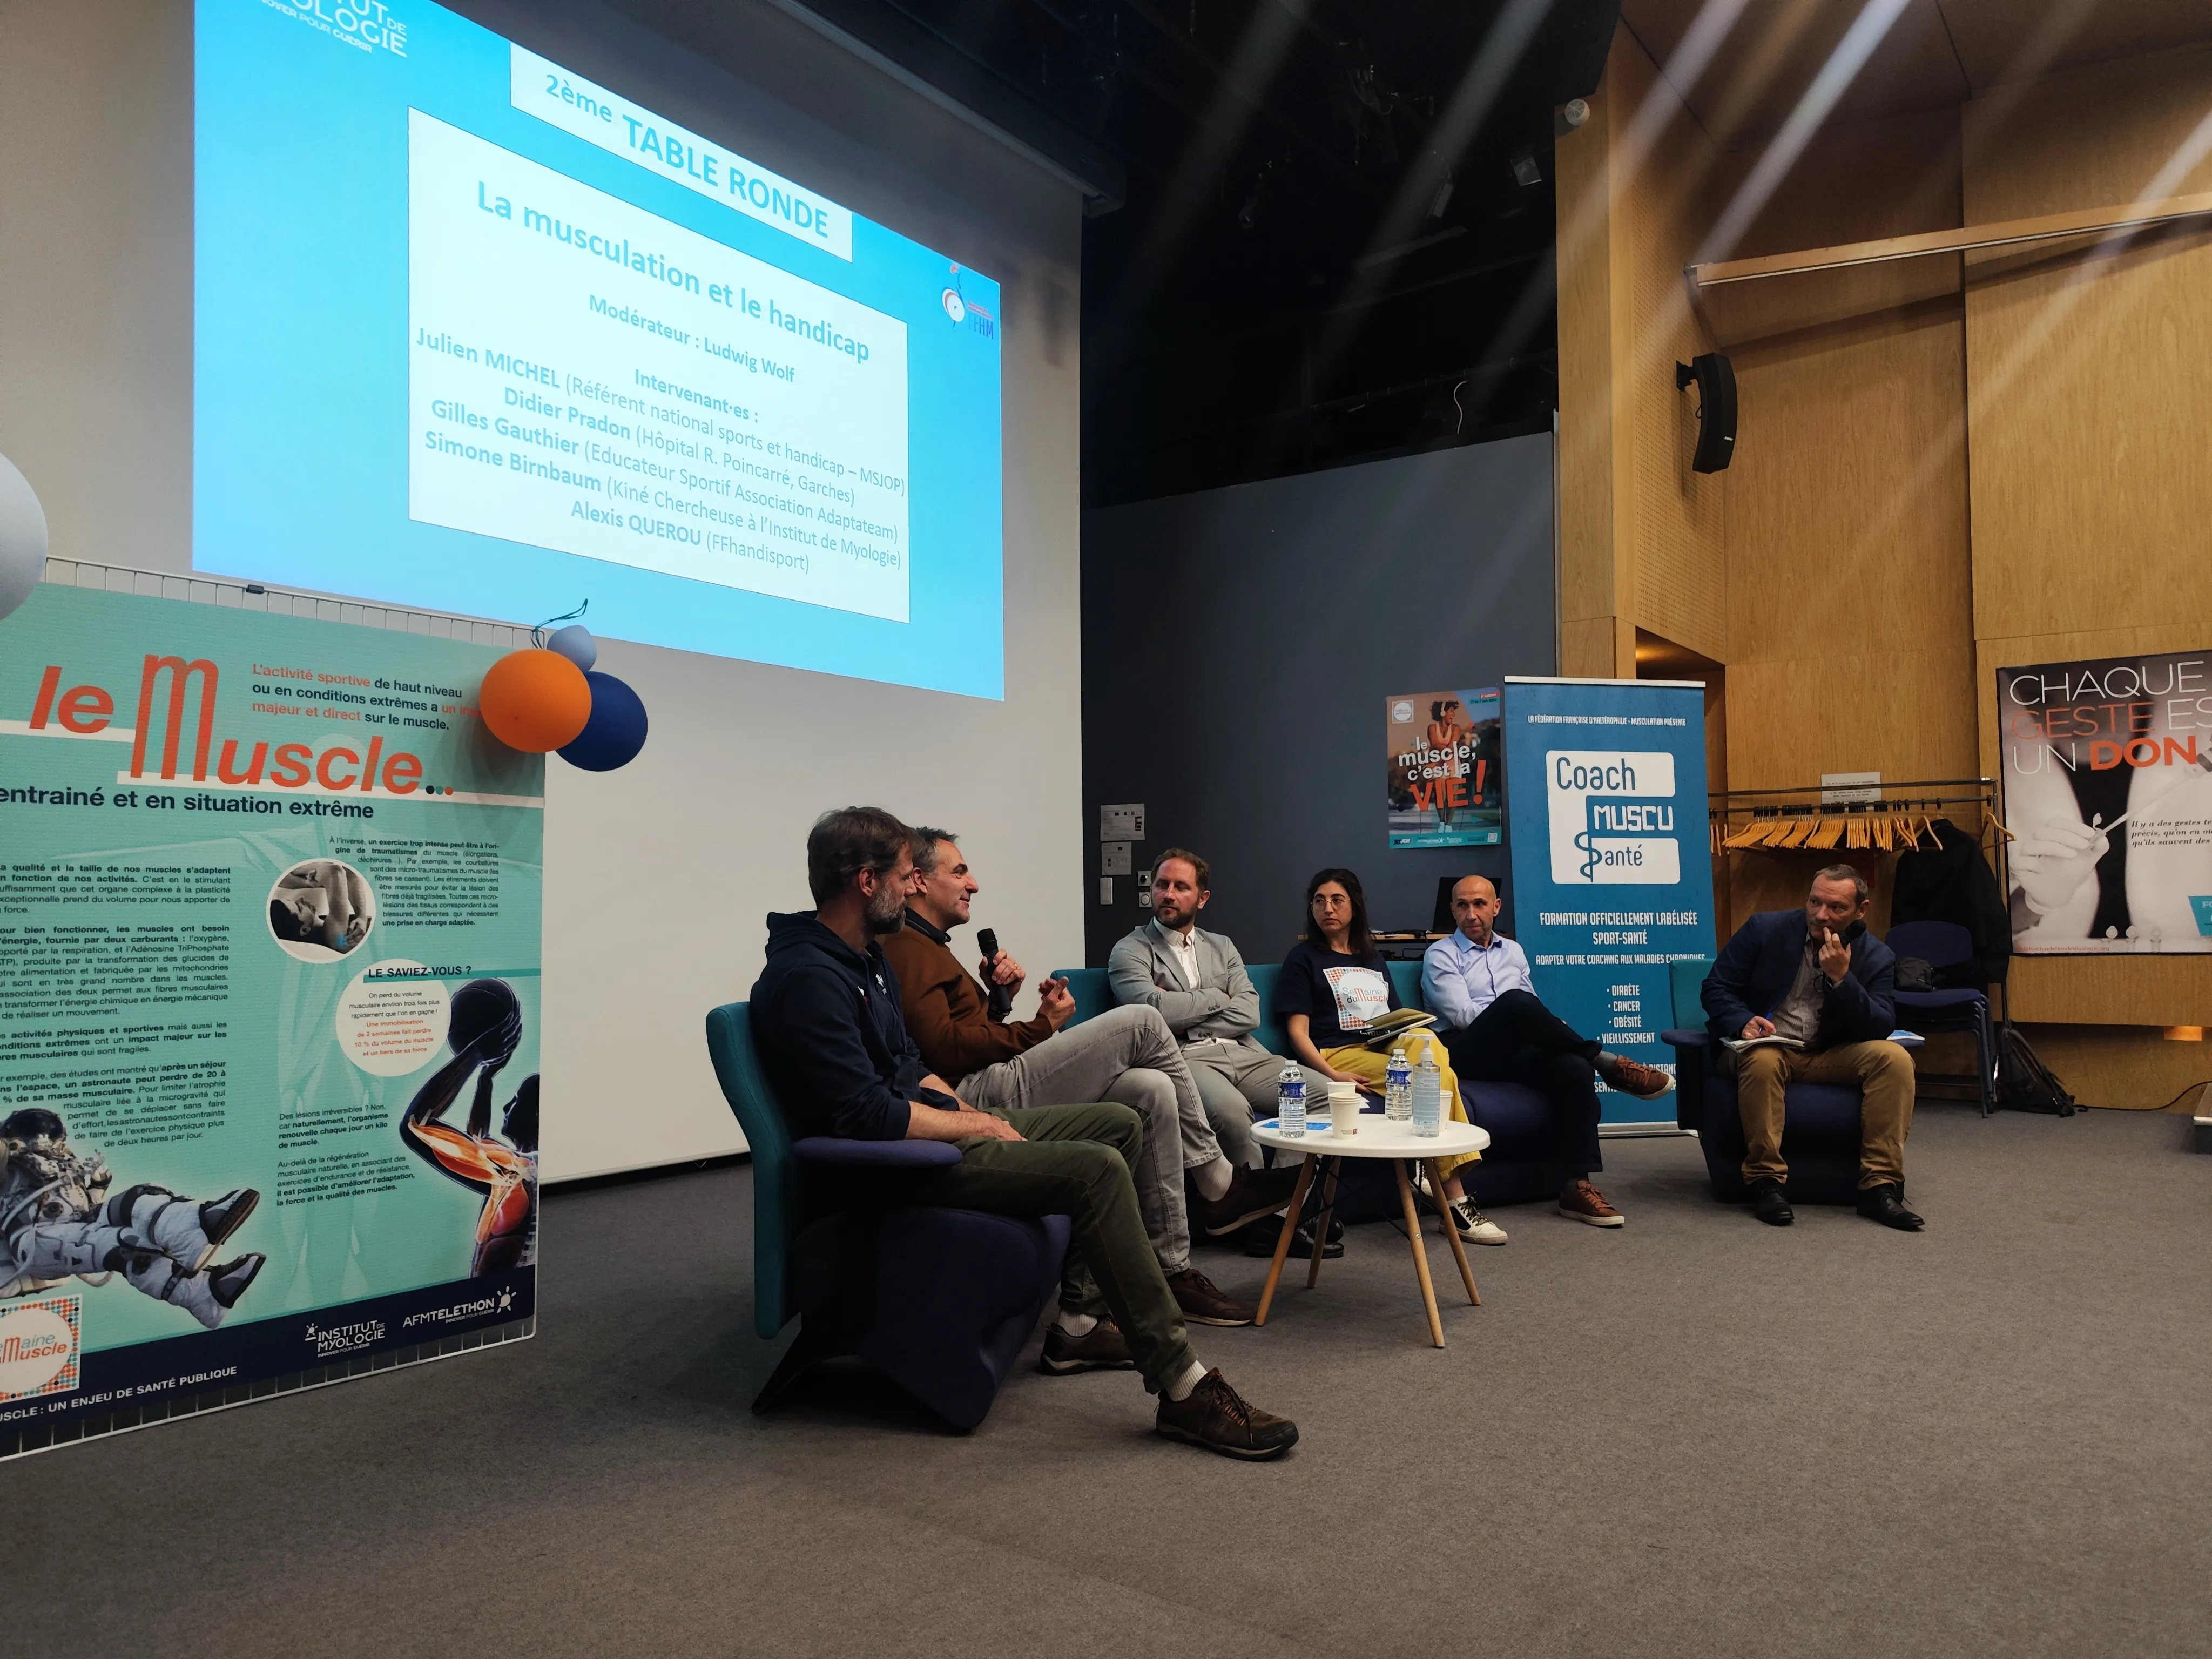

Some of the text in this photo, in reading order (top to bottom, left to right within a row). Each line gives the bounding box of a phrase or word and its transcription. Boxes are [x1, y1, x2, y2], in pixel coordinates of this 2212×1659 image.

[387, 17, 407, 36] DE
[546, 74, 828, 238] 2ème TABLE RONDE
[478, 181, 869, 363] La musculation et le handicap
[590, 294, 690, 345] Modérateur
[704, 337, 757, 373] Ludwig
[761, 358, 795, 382] Wolf
[416, 328, 477, 362] Julien
[486, 349, 560, 388] MICHEL
[566, 374, 645, 415] (Référent
[651, 404, 713, 436] national
[718, 425, 763, 450] sports
[767, 441, 780, 456] et
[785, 443, 844, 476] handicap
[860, 467, 905, 497] MSJOP)
[504, 387, 854, 507] Didier Pradon (Hôpital R. Poincarré, Garches)
[431, 400, 898, 544] Gilles Gauthier (Educateur Sportif Association Adaptateam)
[426, 431, 503, 467] Simone
[510, 453, 601, 491] Birnbaum
[607, 477, 649, 503] (Kiné
[655, 491, 743, 527] Chercheuse
[748, 514, 756, 530] à
[821, 533, 836, 550] de
[841, 538, 901, 570] Myologie)
[571, 501, 810, 575] Alexis QUEROU (FFhandisport)
[253, 664, 462, 697] L'activité sportive de haut niveau
[2009, 660, 2206, 705] CHAQUE
[30, 666, 114, 733] le
[252, 684, 270, 694] ou
[275, 686, 292, 696] en
[296, 688, 366, 704] conditions
[370, 696, 427, 711] extrêmes
[431, 704, 438, 712] a
[442, 704, 455, 714] un
[252, 702, 449, 730] majeur et direct sur le muscle.
[1528, 715, 1534, 723] LA
[1535, 714, 1562, 724] FÉDÉRATION
[1563, 716, 1588, 725] FRANÇAISE
[1631, 717, 1663, 725] MUSCULATION
[1664, 717, 1686, 726] PRÉSENTE
[2012, 701, 2155, 739] GESTE
[1398, 741, 1476, 770] muscle,
[1415, 736, 1428, 751] le
[2013, 735, 2197, 775] UN DON
[1407, 763, 1449, 781] c'est
[1556, 757, 1636, 790] Coach
[0, 786, 374, 818] entrainé et en situation extrême
[1594, 805, 1674, 831] MUSCU
[2174, 820, 2201, 828] gestes
[2132, 830, 2160, 839] précis,
[1540, 909, 1697, 925] FORMATION OFFICIELLEMENT LABÉLISÉE
[1593, 929, 1648, 945] SPORT-SANTÉ
[368, 969, 383, 978] LE
[387, 967, 462, 977] SAVIEZ-VOUS
[1536, 955, 1564, 965] ADAPTER
[1565, 954, 1586, 964] VOTRE
[1587, 954, 1619, 964] COACHING
[1621, 954, 1633, 964] AUX
[1634, 954, 1664, 964] MALADIES
[1612, 983, 1640, 996] DIABÈTE
[1613, 1001, 1640, 1011] CANCER
[1614, 1014, 1642, 1028] OBÉSITÉ
[1602, 1032, 1655, 1044] VIEILLISSEMENT
[279, 1129, 318, 1139] renouvelle
[320, 1127, 347, 1135] chaque
[318, 1320, 377, 1341] INSTITUT
[318, 1328, 385, 1352] MYOLOGIE
[48, 1401, 66, 1412] UN
[71, 1393, 112, 1408] ENJEU
[117, 1387, 133, 1399] DE
[137, 1377, 176, 1395] SANTÉ
[180, 1366, 238, 1386] PUBLIQUE
